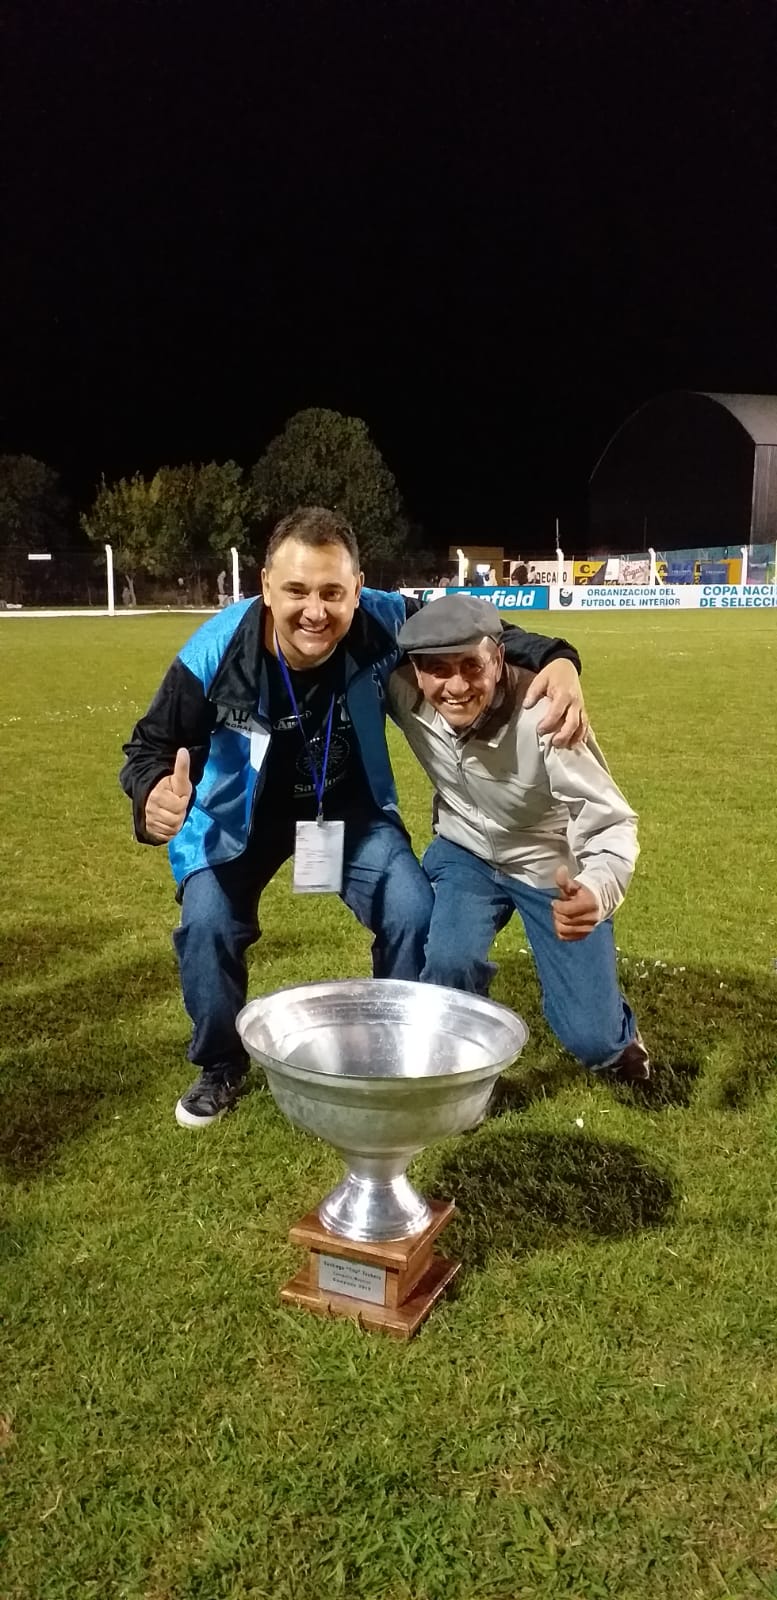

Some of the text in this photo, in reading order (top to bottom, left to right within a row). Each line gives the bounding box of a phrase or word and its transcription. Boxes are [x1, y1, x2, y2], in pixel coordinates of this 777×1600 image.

[536, 571, 568, 584] DECAO
[587, 588, 676, 597] ORGANIZACION DEL
[703, 585, 777, 596] COPA NACI
[455, 589, 536, 607] nfield
[581, 598, 681, 607] FUTBOL DEL INTERIOR
[699, 597, 777, 607] DE SELECCI
